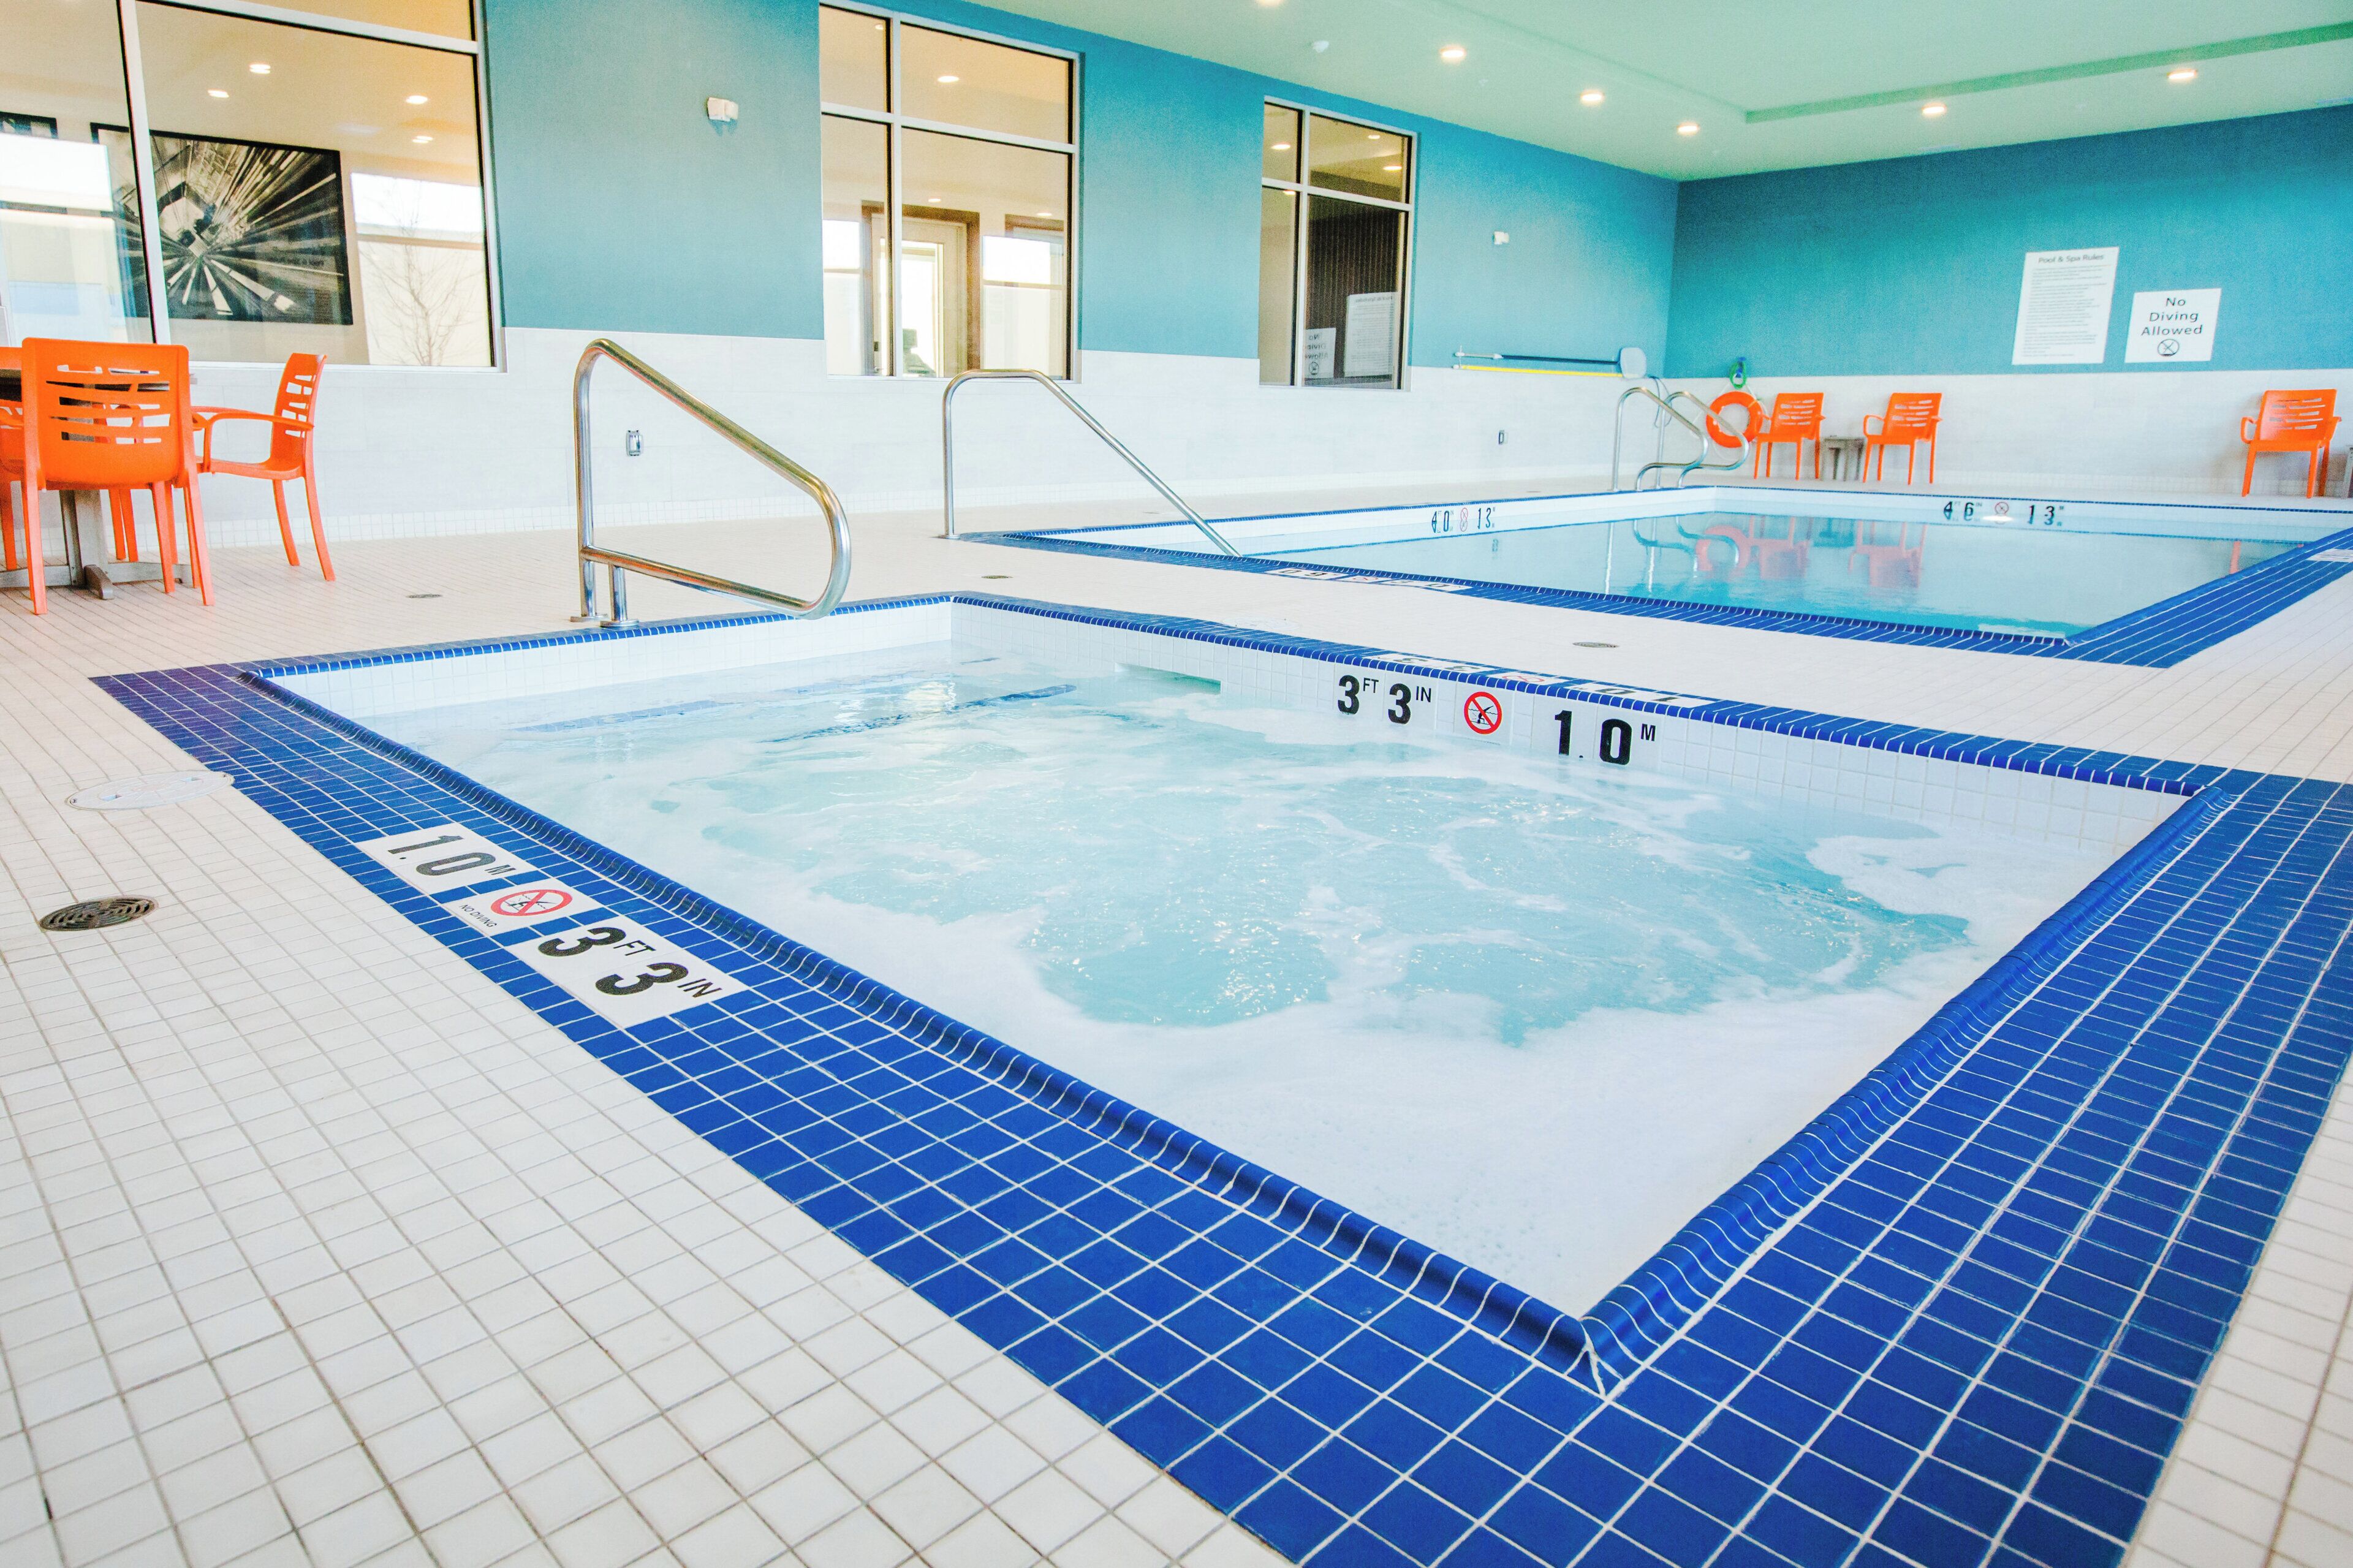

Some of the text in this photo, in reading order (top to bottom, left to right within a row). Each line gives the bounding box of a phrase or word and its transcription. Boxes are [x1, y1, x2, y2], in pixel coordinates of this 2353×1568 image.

[2165, 298, 2186, 306] No
[2150, 311, 2199, 322] Diving
[2141, 325, 2203, 336] Allowed
[1640, 723, 1656, 741] M
[484, 865, 516, 875] M
[469, 911, 497, 928] DIVING
